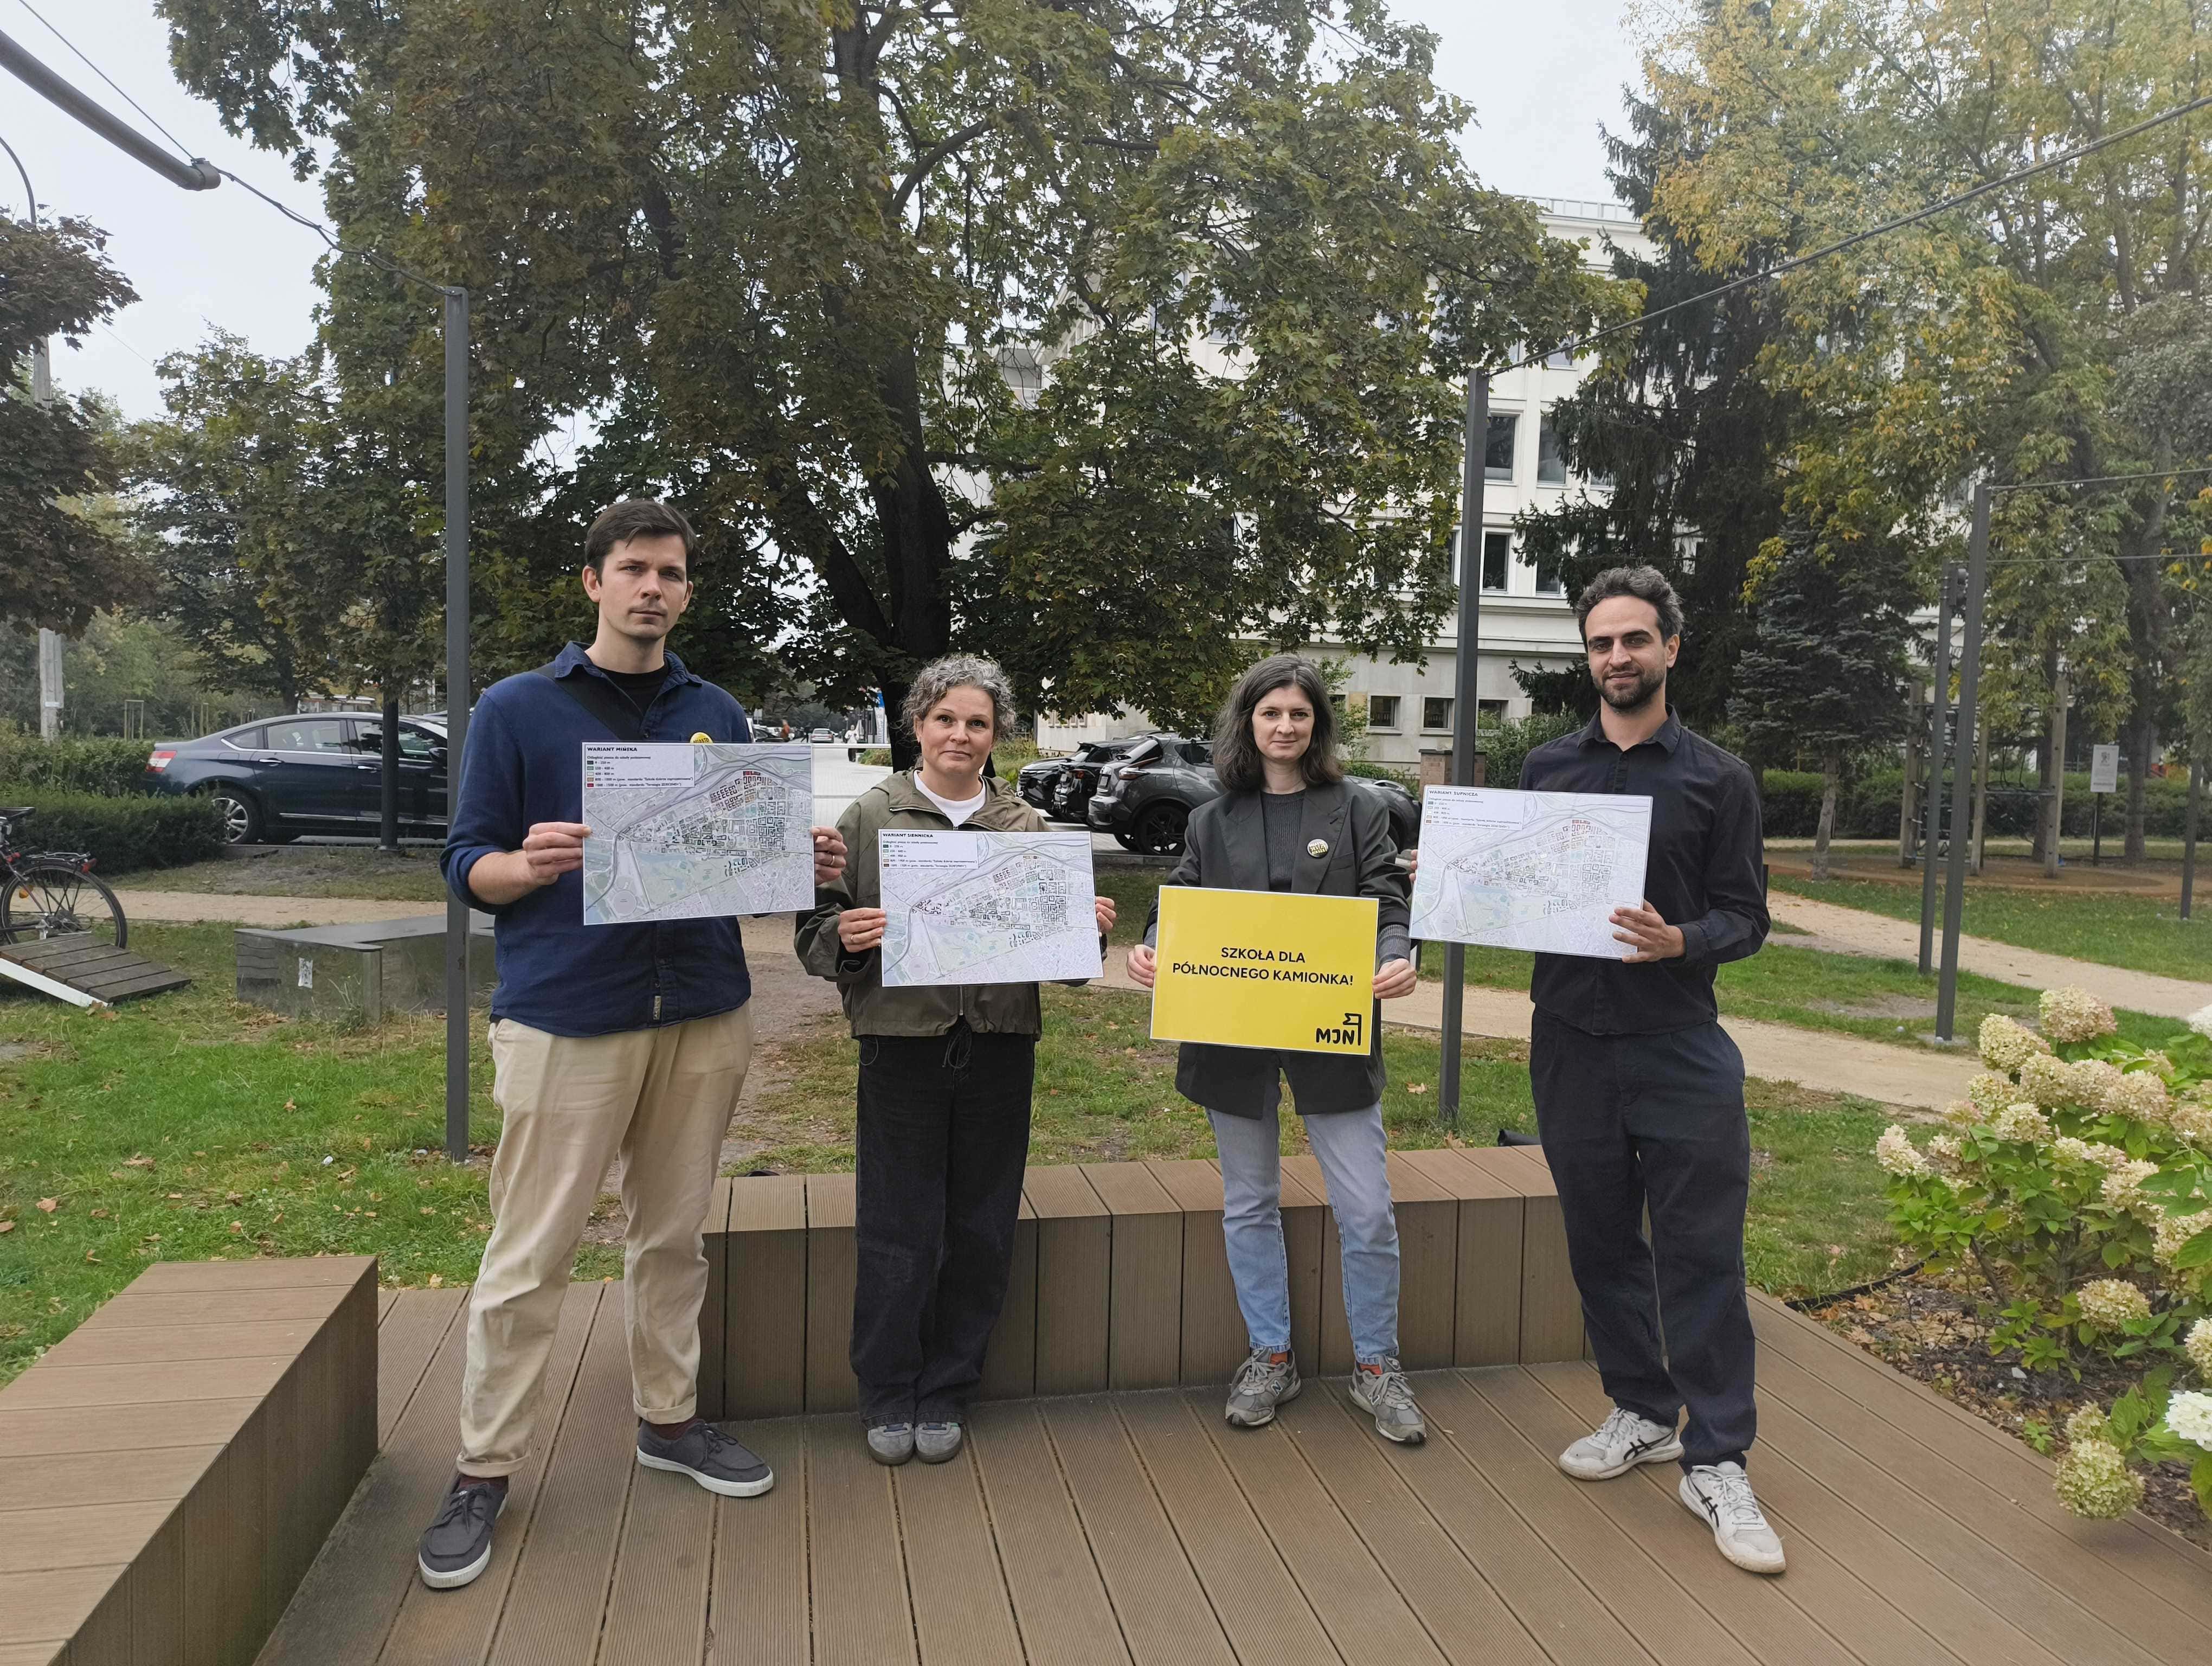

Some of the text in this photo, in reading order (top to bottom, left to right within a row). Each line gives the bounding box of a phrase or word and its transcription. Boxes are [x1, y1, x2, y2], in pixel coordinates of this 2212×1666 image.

[1221, 947, 1306, 963] SZKOŁA DLA
[1173, 961, 1353, 986] PÓŁNOCNEGO KAMIONKA!
[1316, 1028, 1355, 1045] MJN
